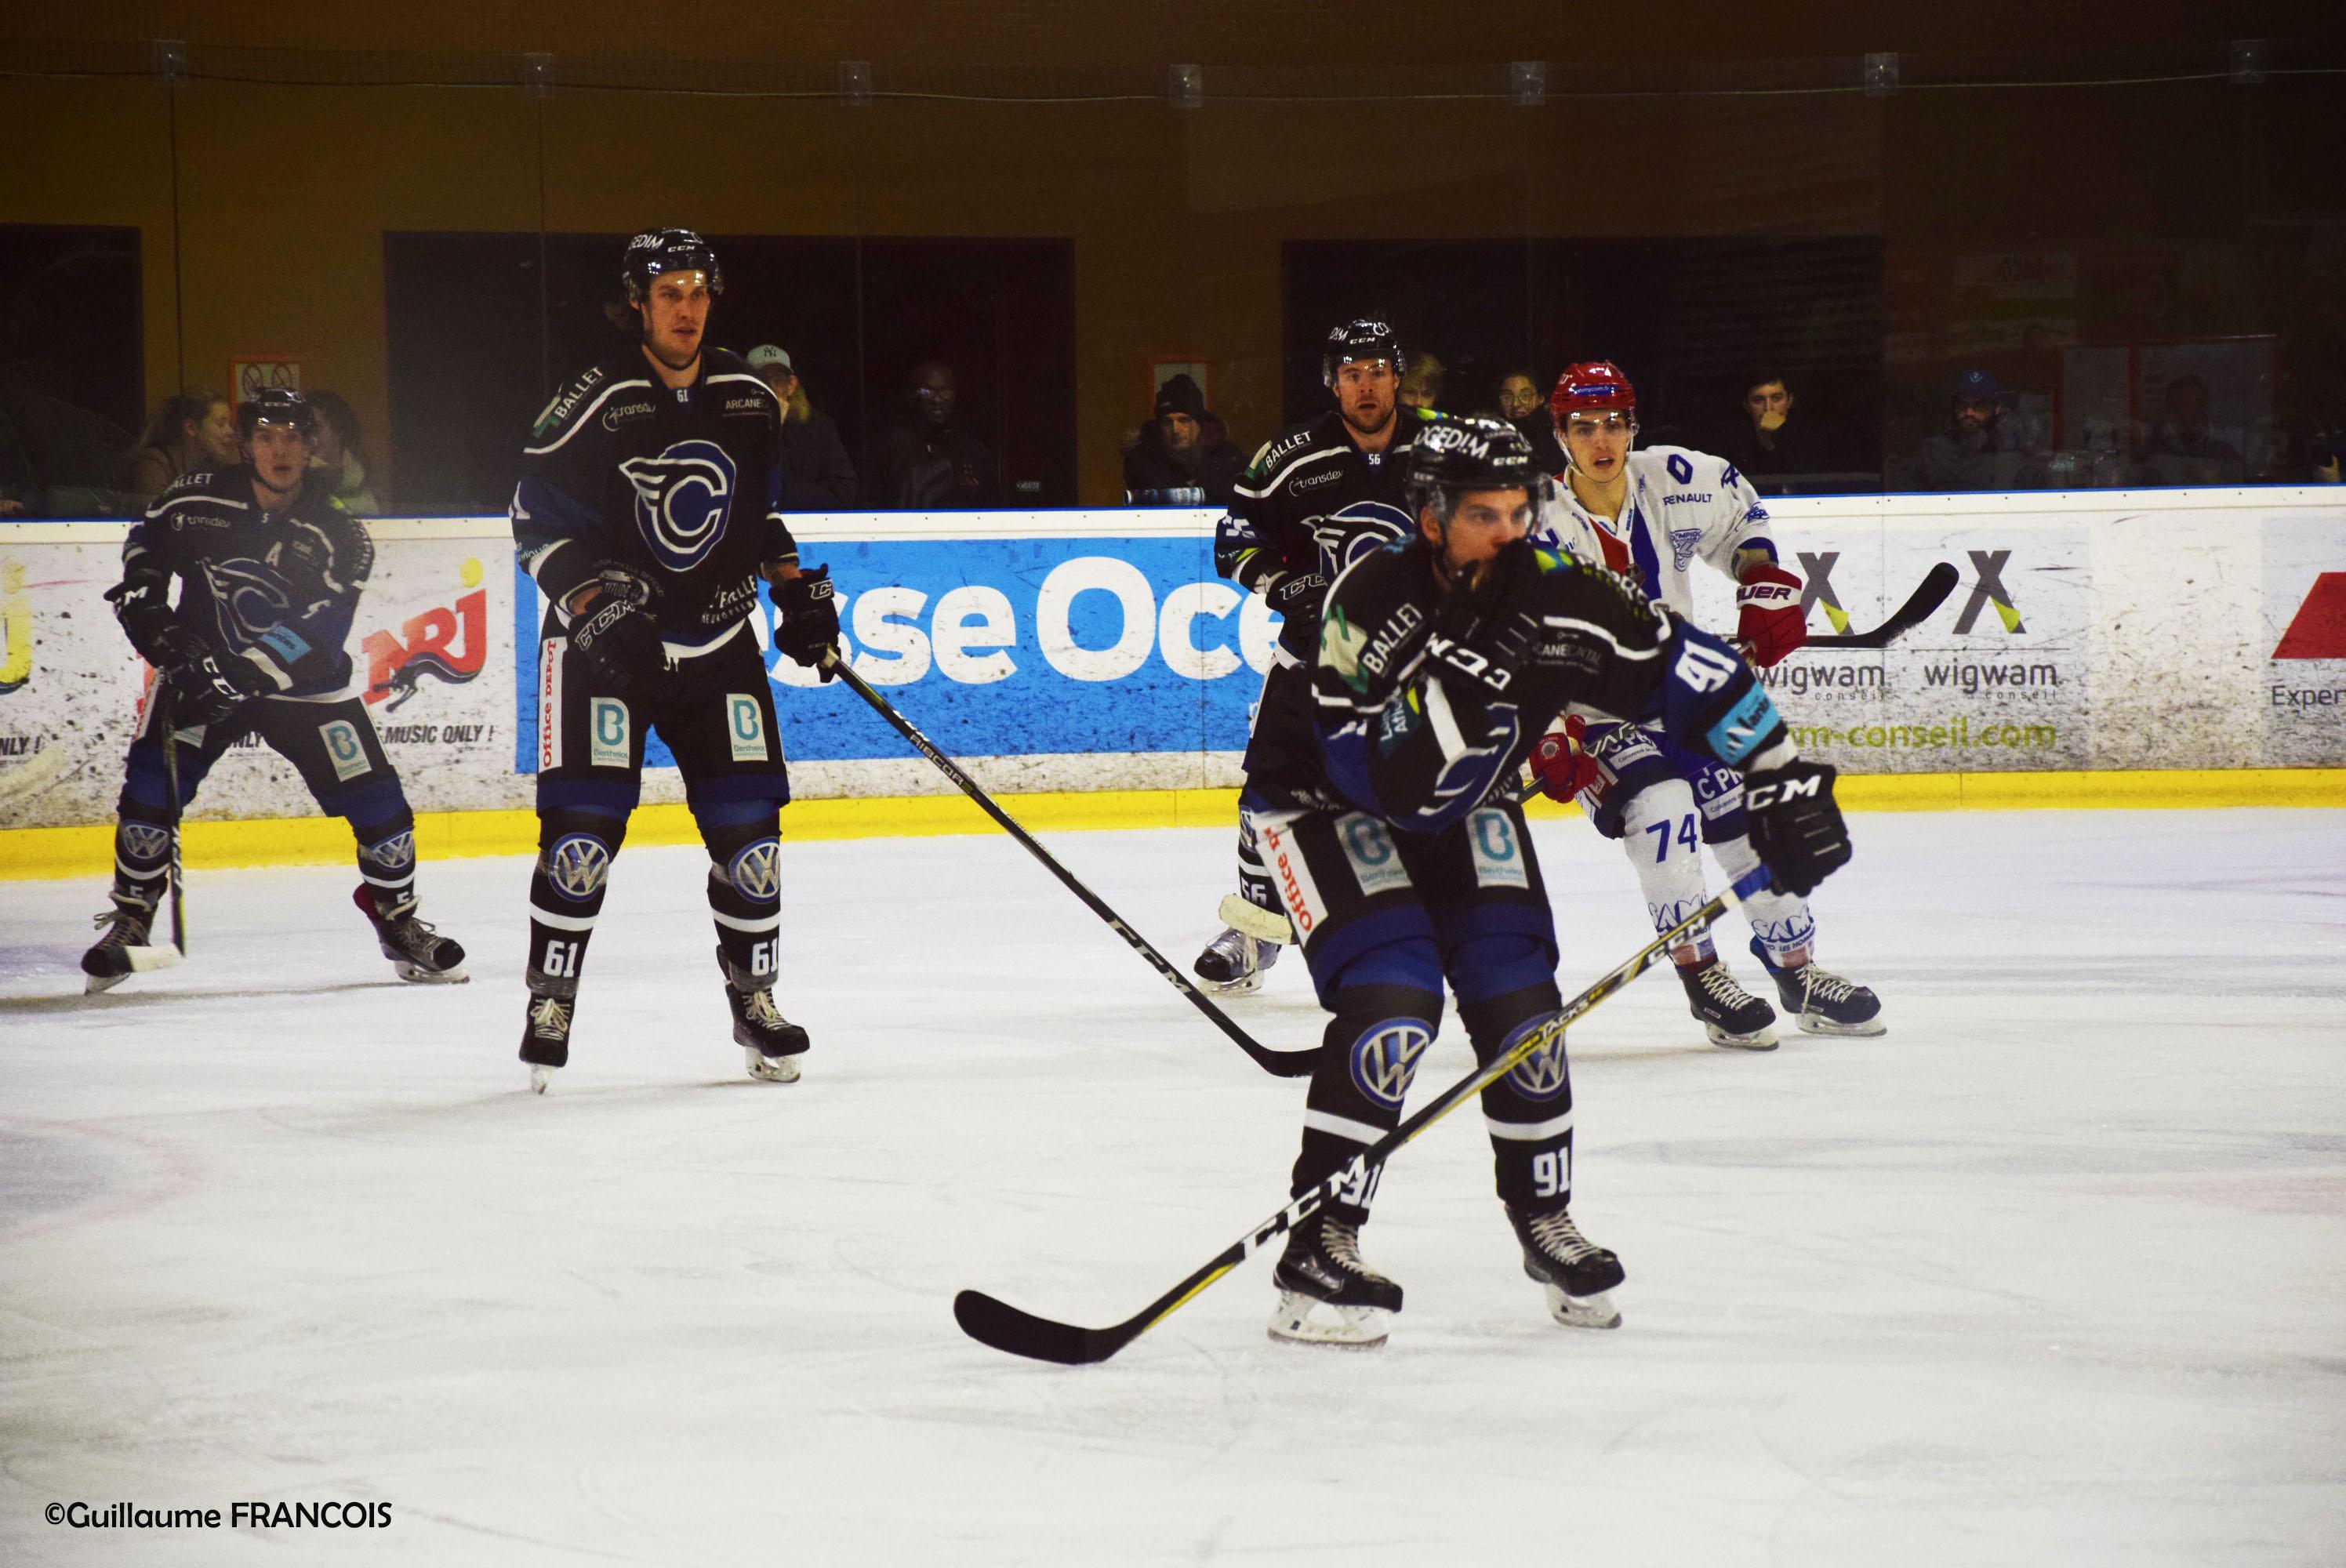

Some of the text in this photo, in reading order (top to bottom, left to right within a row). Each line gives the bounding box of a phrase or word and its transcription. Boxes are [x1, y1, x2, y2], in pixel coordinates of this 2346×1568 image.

[554, 365, 604, 420] BALLET
[677, 390, 688, 402] 61
[1266, 430, 1312, 469] BALLET
[1368, 453, 1381, 465] 56
[1493, 456, 1528, 466] CCM
[1299, 469, 1344, 490] transdev
[1662, 492, 1713, 506] RENAULT
[575, 600, 635, 652] CCM
[1363, 602, 1423, 677] BALLET
[1676, 648, 1738, 693] 91
[2272, 684, 2346, 710] Exper
[384, 725, 438, 745] MUSIC
[442, 724, 484, 744] ONLY
[543, 701, 552, 768] Office
[910, 733, 964, 785] RIBCOR
[1746, 775, 1821, 811] CM
[1646, 813, 1698, 863] 74
[1277, 851, 1313, 932] Office
[543, 940, 579, 978] 61
[751, 937, 779, 978] 61
[1533, 1146, 1570, 1198] 91
